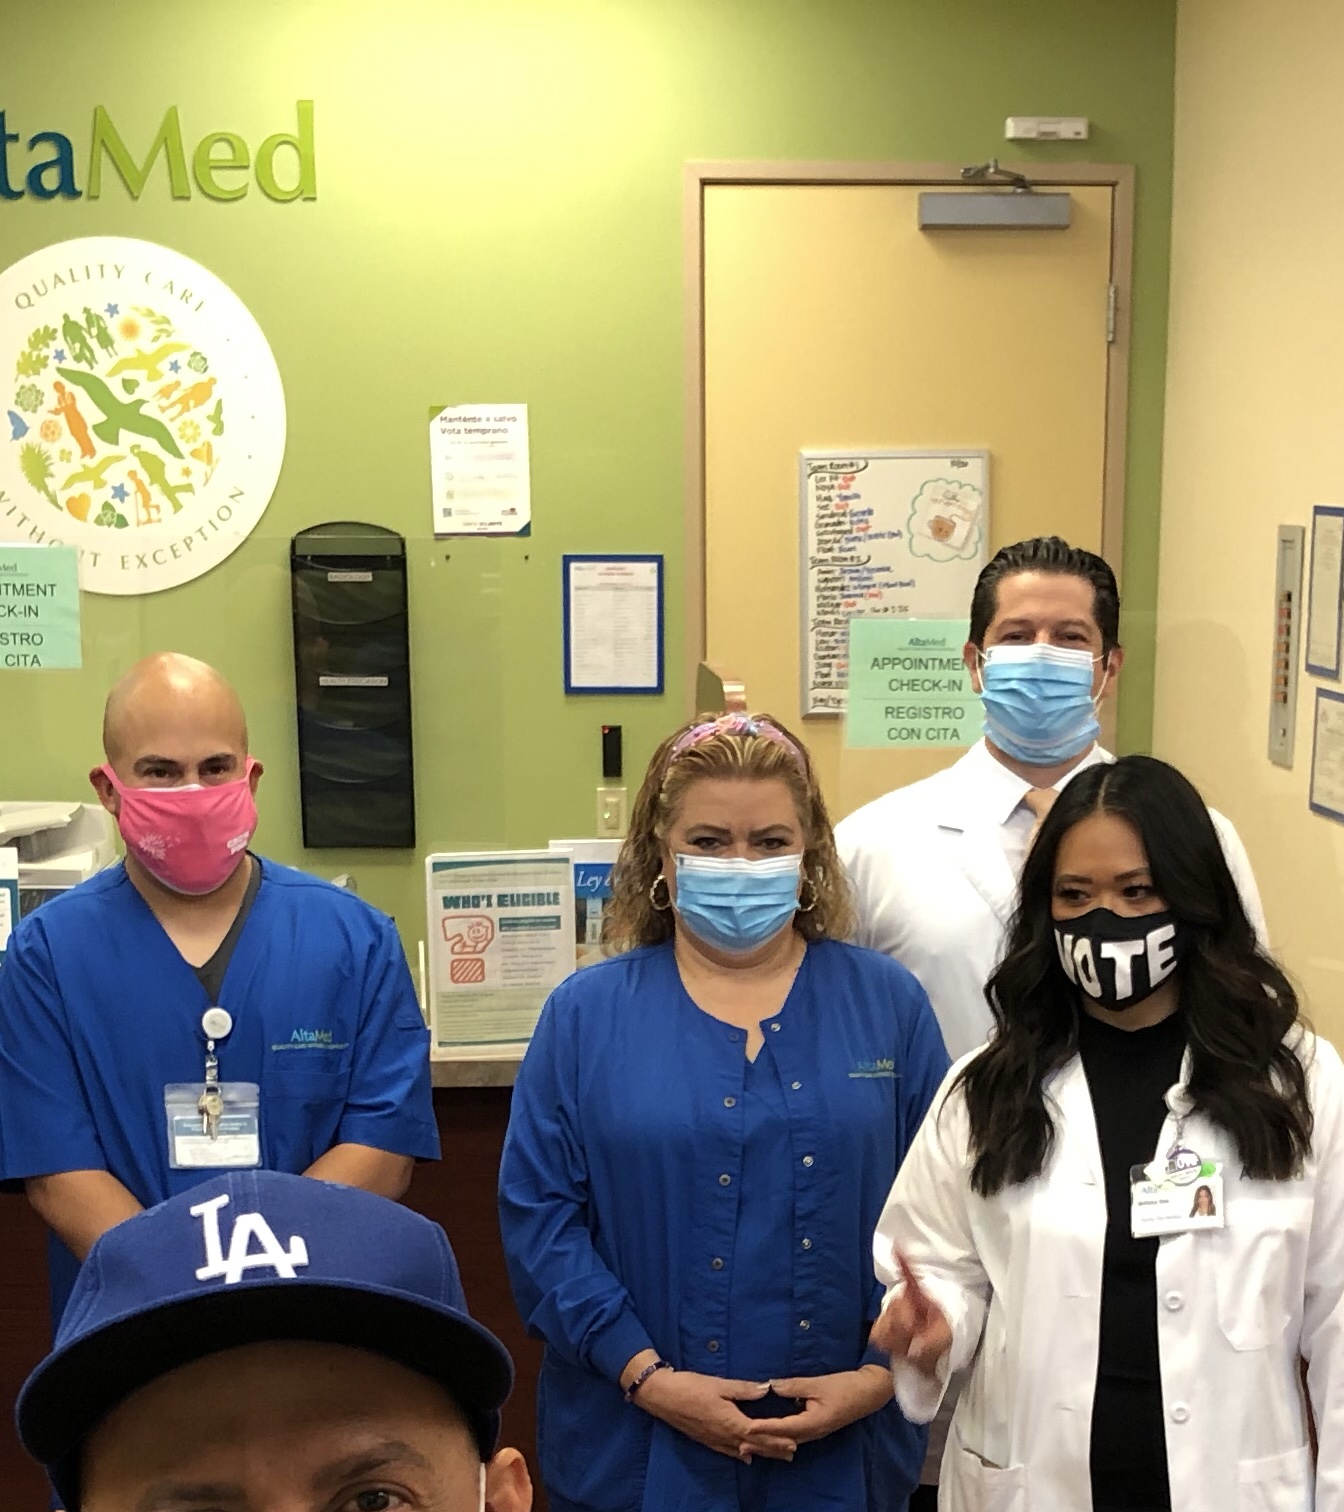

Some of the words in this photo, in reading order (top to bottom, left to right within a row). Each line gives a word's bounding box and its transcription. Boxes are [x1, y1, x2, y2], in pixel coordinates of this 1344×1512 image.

[15, 264, 126, 310] QUALITY
[121, 485, 246, 571] EXCEPTION
[5, 654, 41, 668] CITA
[870, 657, 965, 671] APPOINTME
[888, 678, 963, 692] CHECK-IN
[884, 706, 965, 720] REGISTRO
[887, 727, 921, 741] CON
[925, 728, 960, 741] CITA
[577, 871, 603, 892] Ley
[442, 894, 492, 910] WHO'S
[497, 892, 560, 908] ELIGIBLE
[1054, 923, 1177, 1000] VOTE
[190, 1194, 309, 1284] LA
